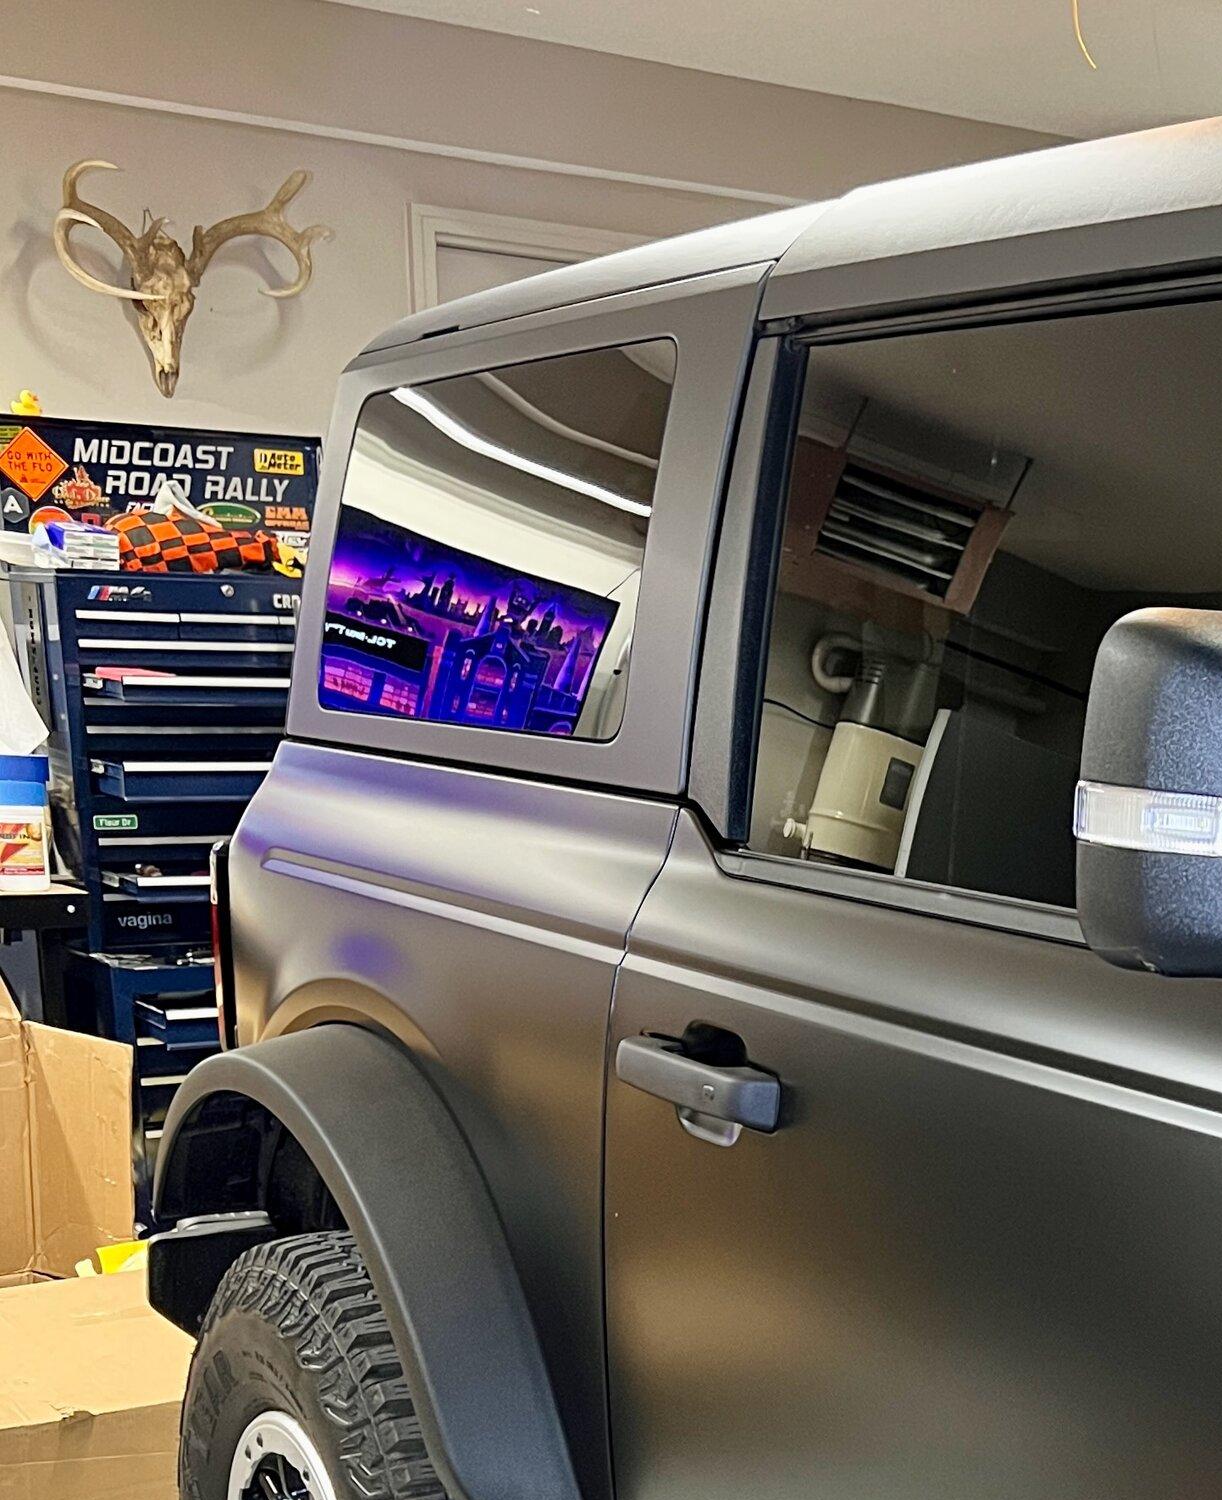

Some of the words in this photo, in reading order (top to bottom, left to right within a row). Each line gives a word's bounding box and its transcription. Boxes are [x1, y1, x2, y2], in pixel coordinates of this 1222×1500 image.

[7, 450, 21, 460] GO
[26, 451, 52, 460] WITH
[72, 437, 235, 471] MIDCOAST
[270, 452, 296, 463] Auto
[8, 461, 28, 472] THE
[32, 462, 53, 473] FLO
[268, 461, 301, 472] Meter
[105, 469, 192, 499] ROAD
[204, 475, 290, 503] RALLY
[117, 911, 173, 930] vagina
